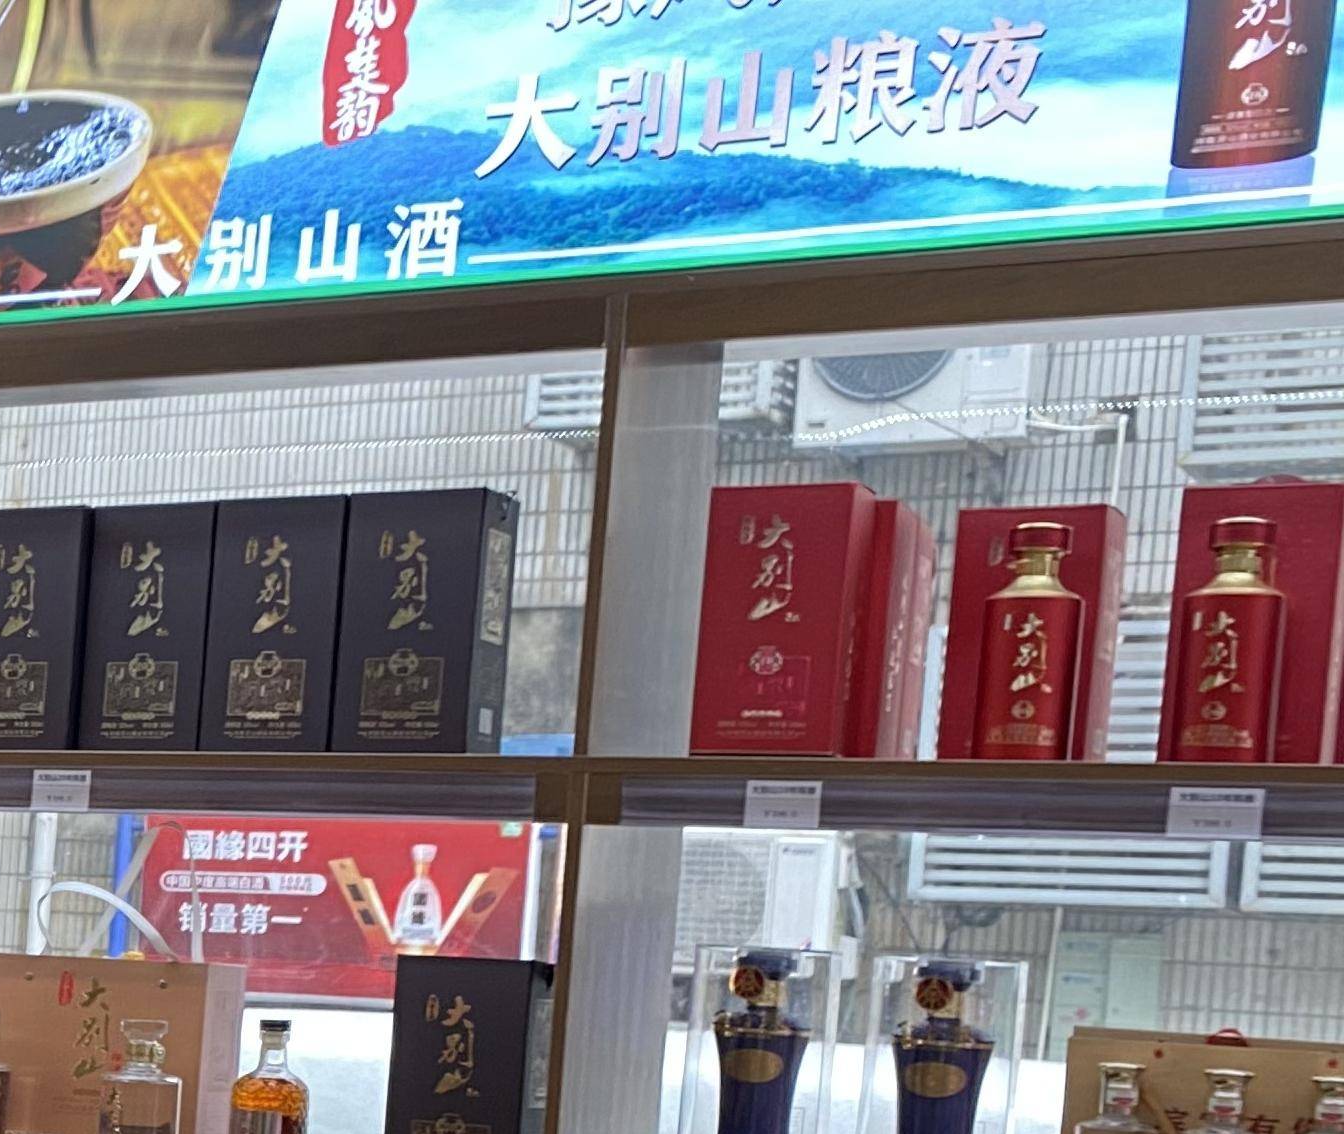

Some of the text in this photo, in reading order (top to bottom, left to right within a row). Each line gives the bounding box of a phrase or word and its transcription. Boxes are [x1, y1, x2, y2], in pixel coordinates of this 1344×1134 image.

[473, 17, 1048, 180] 大别山粮液
[110, 196, 465, 305] 大别山酒
